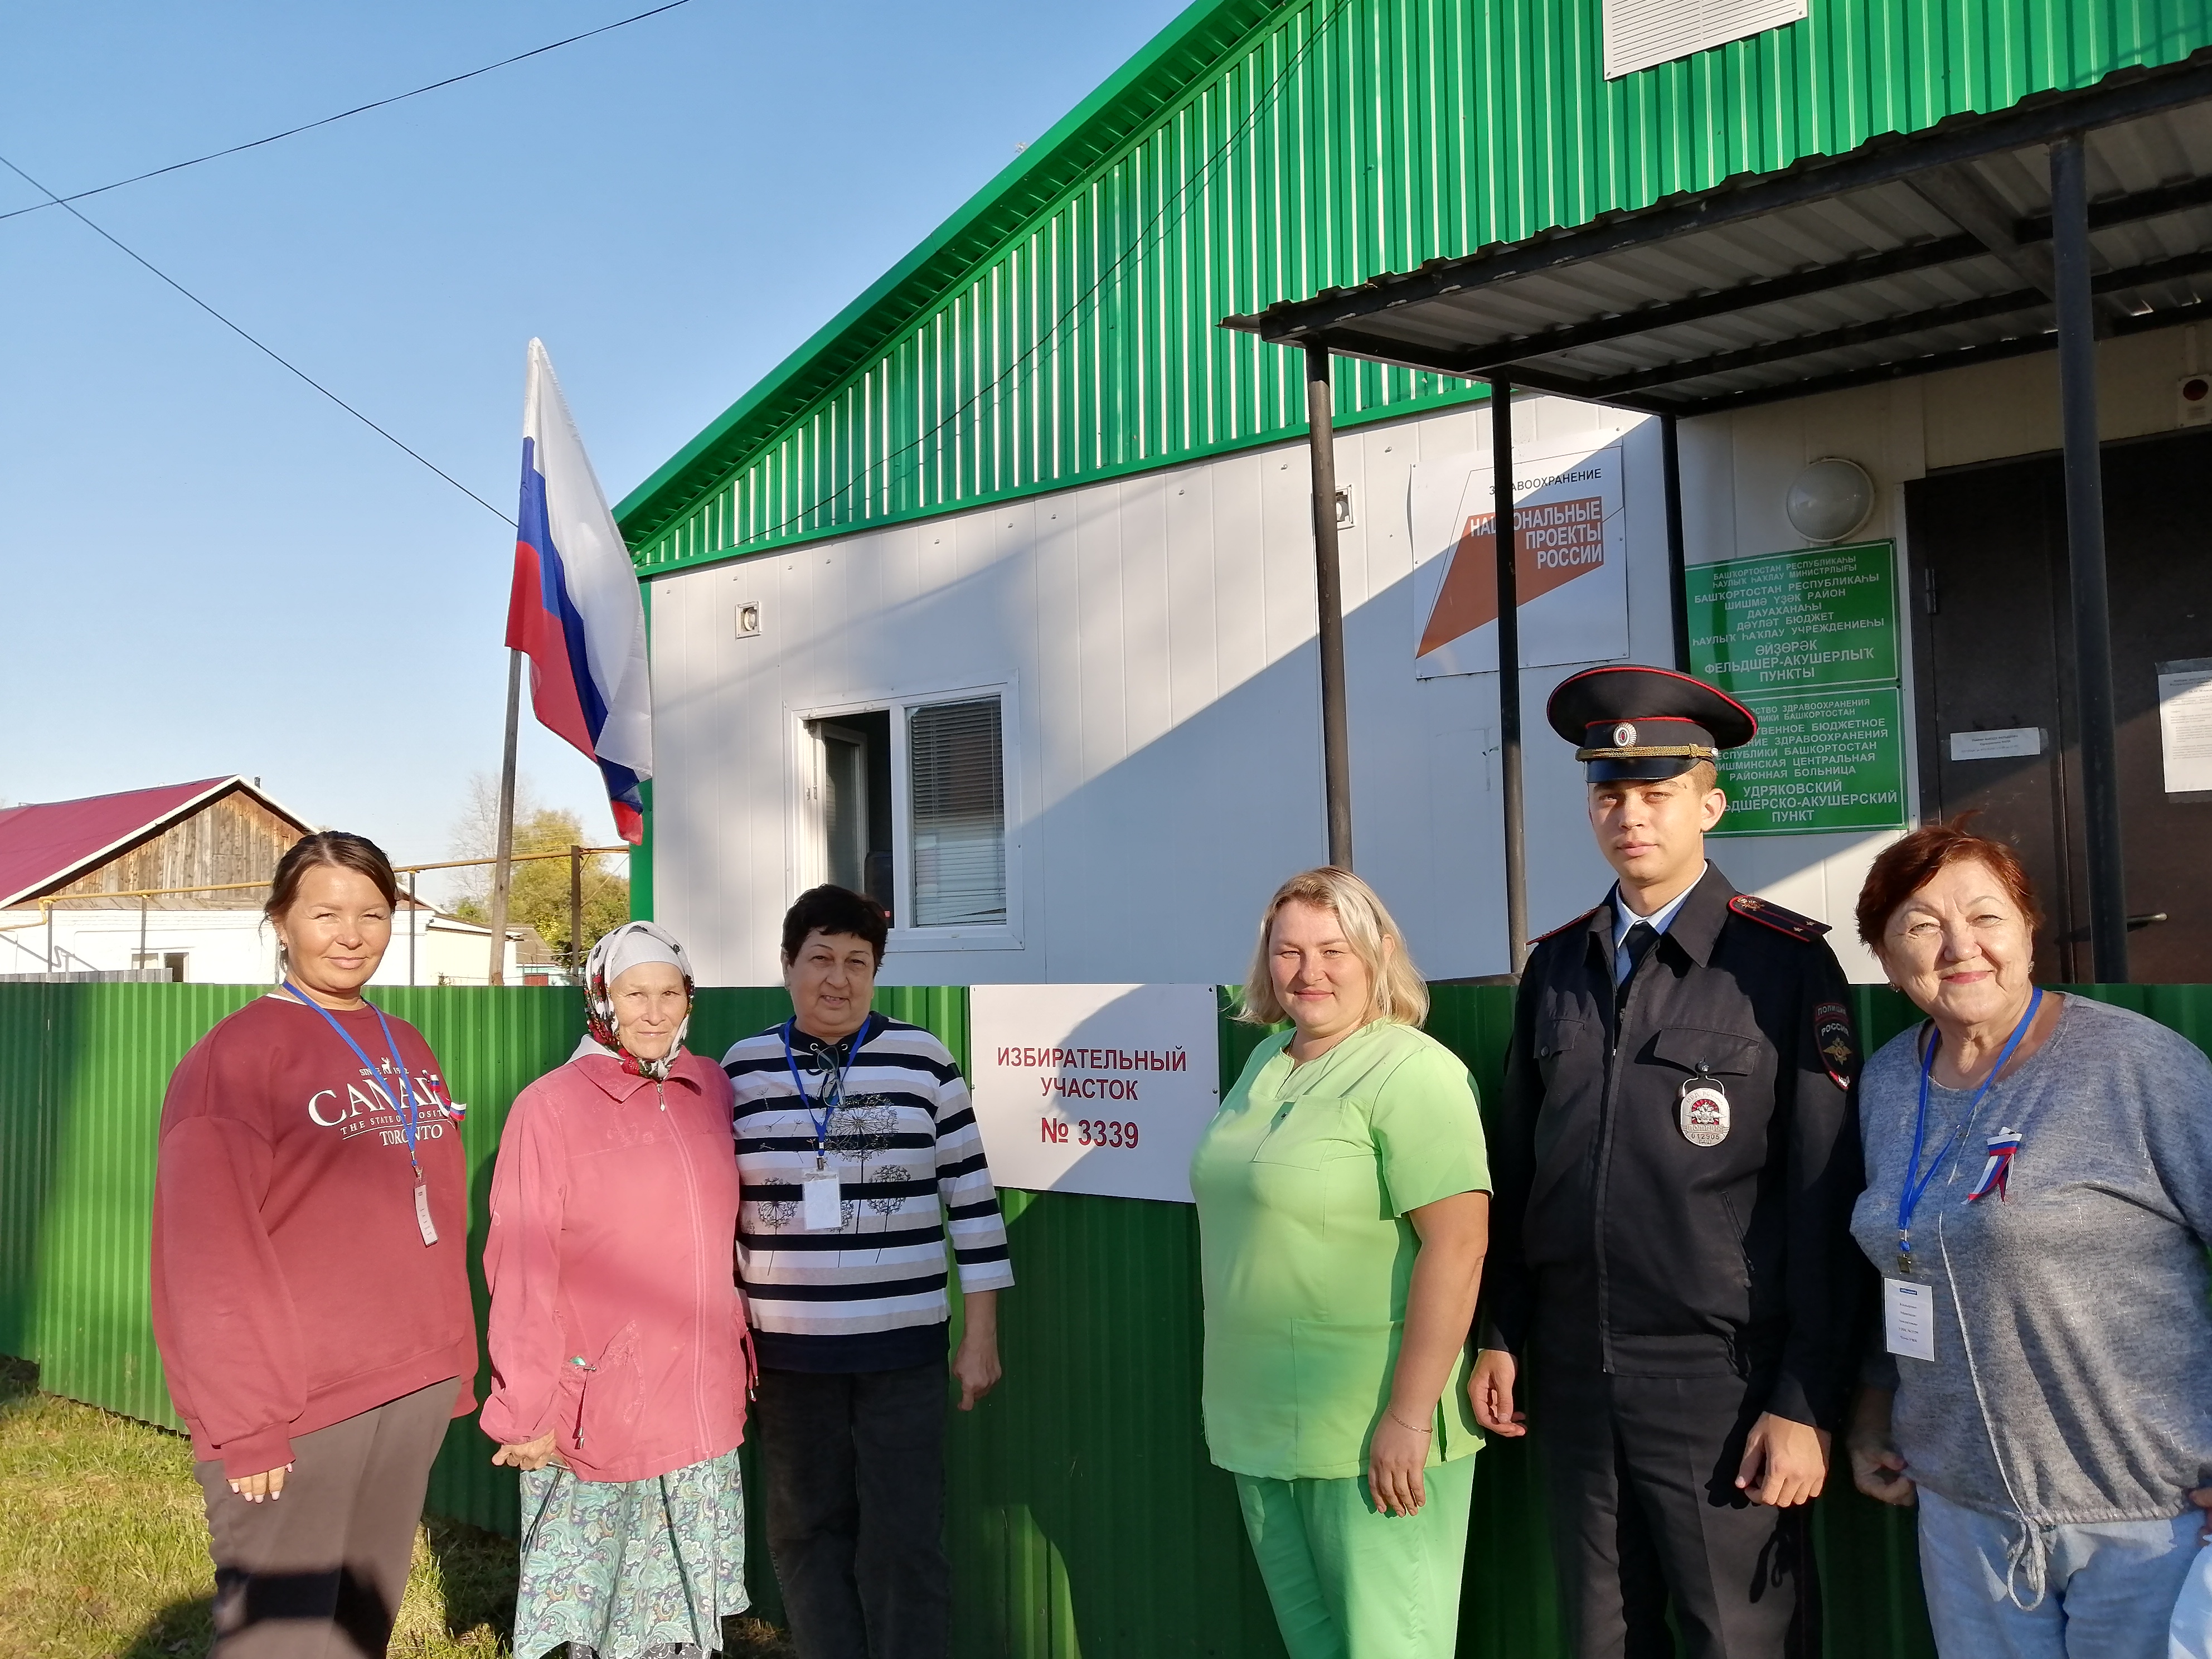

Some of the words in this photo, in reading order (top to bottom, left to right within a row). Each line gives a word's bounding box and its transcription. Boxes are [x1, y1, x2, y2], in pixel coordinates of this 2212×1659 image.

[1489, 468, 1602, 495] ЗАВООХРАНЕНИЕ
[1526, 522, 1602, 550] ПРОЕКТЫ
[1537, 544, 1602, 569] РОССИИ
[1714, 565, 1782, 581] БАШҠОРТОСТАН
[1694, 585, 1782, 604] БАШҠОРТОСТАН
[1725, 598, 1767, 610] ШИШМӘ
[1807, 588, 1846, 600] РАЙОН
[1786, 612, 1835, 625] БЮДЖЕТ
[1759, 667, 1815, 682] ПУНКТЫ
[1782, 698, 1870, 713] ЗДРАВООХРАНЕНИЯ
[1784, 708, 1855, 721] БАШКОРТОСТАН
[1811, 718, 1885, 732] БЮДЖЕТНОЕ
[1774, 729, 1888, 746] ЗДРАВООХРАНЕНИЯ
[1716, 748, 1778, 761] ЕСПУБЛИКИ
[1784, 741, 1877, 756] БАШКОРТОСТАН
[1793, 753, 1875, 767] ЦЕНТРАЛЬНАЯ
[1730, 770, 1788, 781] РАЙОННАЯ
[1794, 765, 1856, 777] БОЛЬНИЦА
[1743, 779, 1842, 798] УДРЯКОВСКИЙ
[1772, 810, 1815, 822] ПУНКТ
[1821, 1023, 1849, 1037] РОССИЯ
[997, 1045, 1187, 1072] ИЗБИРАТЕЛЬНЫЙ
[1040, 1077, 1138, 1101] УЧАСТОК
[341, 1120, 365, 1135] THE
[370, 1115, 394, 1126] STATE
[1041, 1118, 1069, 1143] №
[1078, 1119, 1139, 1149] 3339
